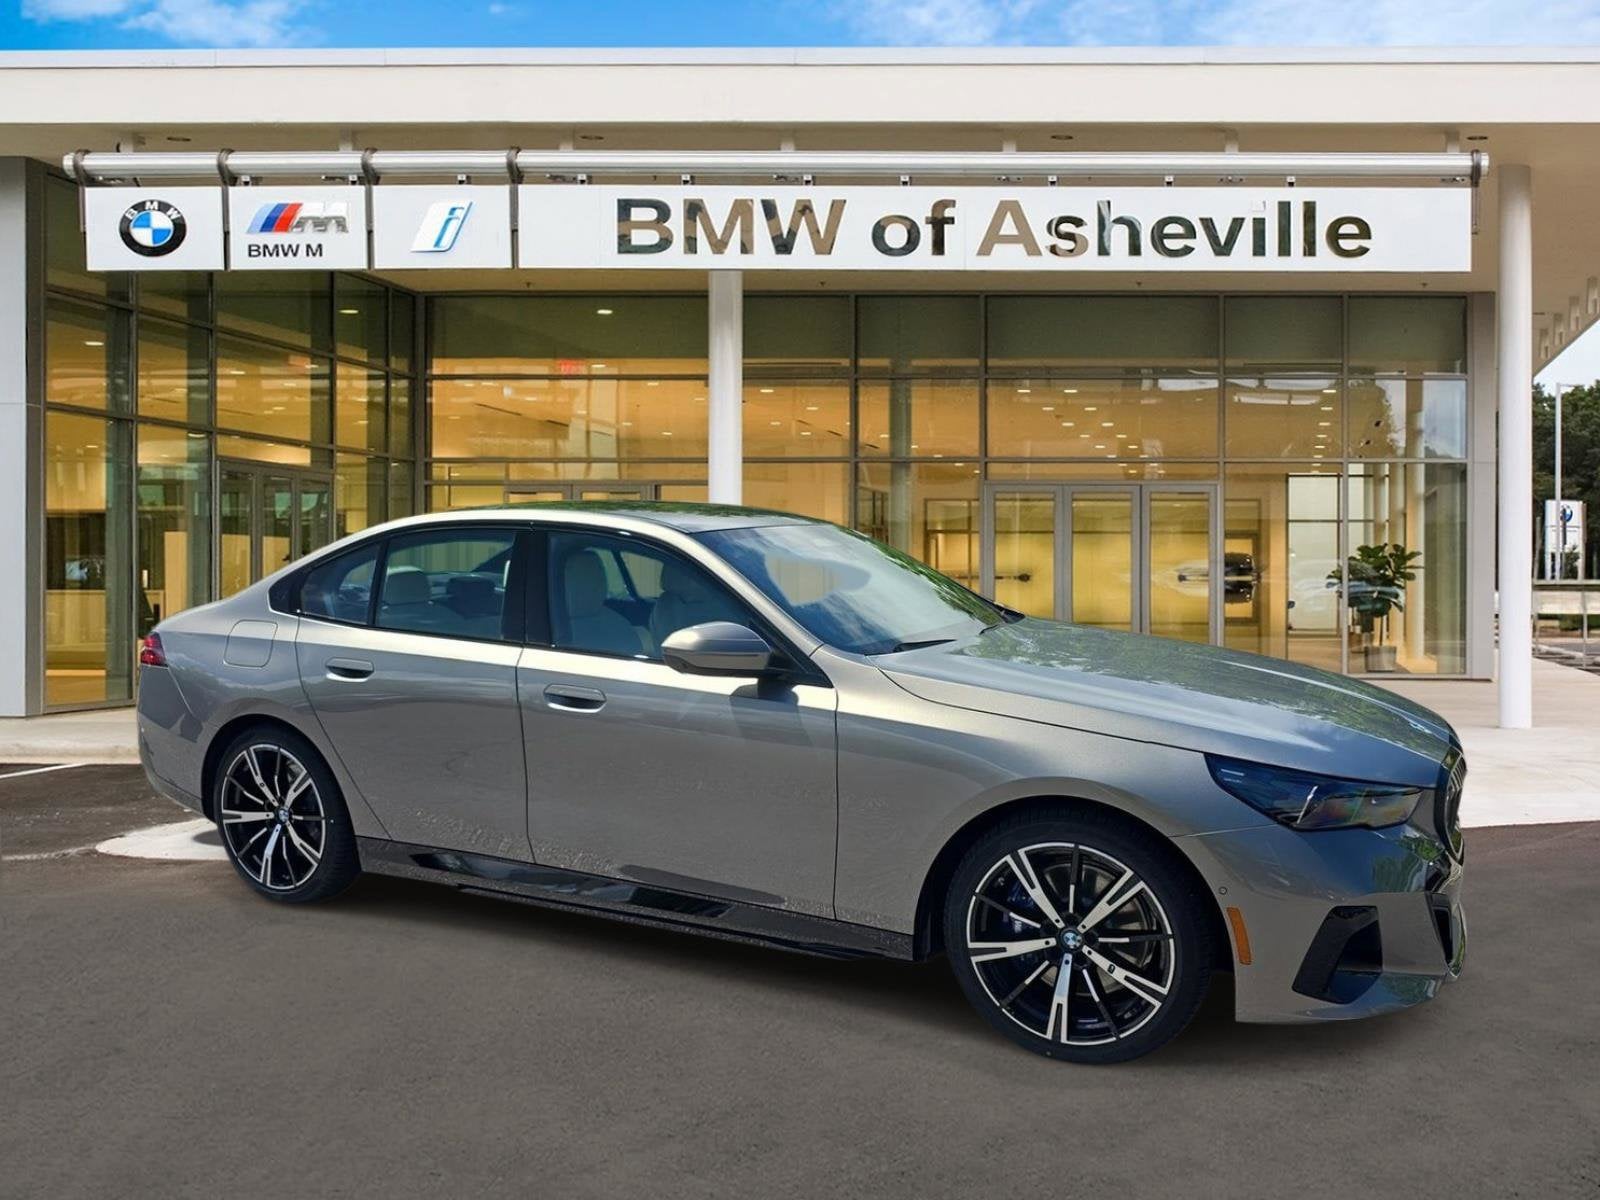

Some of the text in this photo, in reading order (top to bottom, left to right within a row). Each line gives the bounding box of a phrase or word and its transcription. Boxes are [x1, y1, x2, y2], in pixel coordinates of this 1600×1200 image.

[124, 200, 181, 220] BMW
[616, 198, 1373, 258] BMW of Asheville
[247, 243, 323, 258] BMW M
